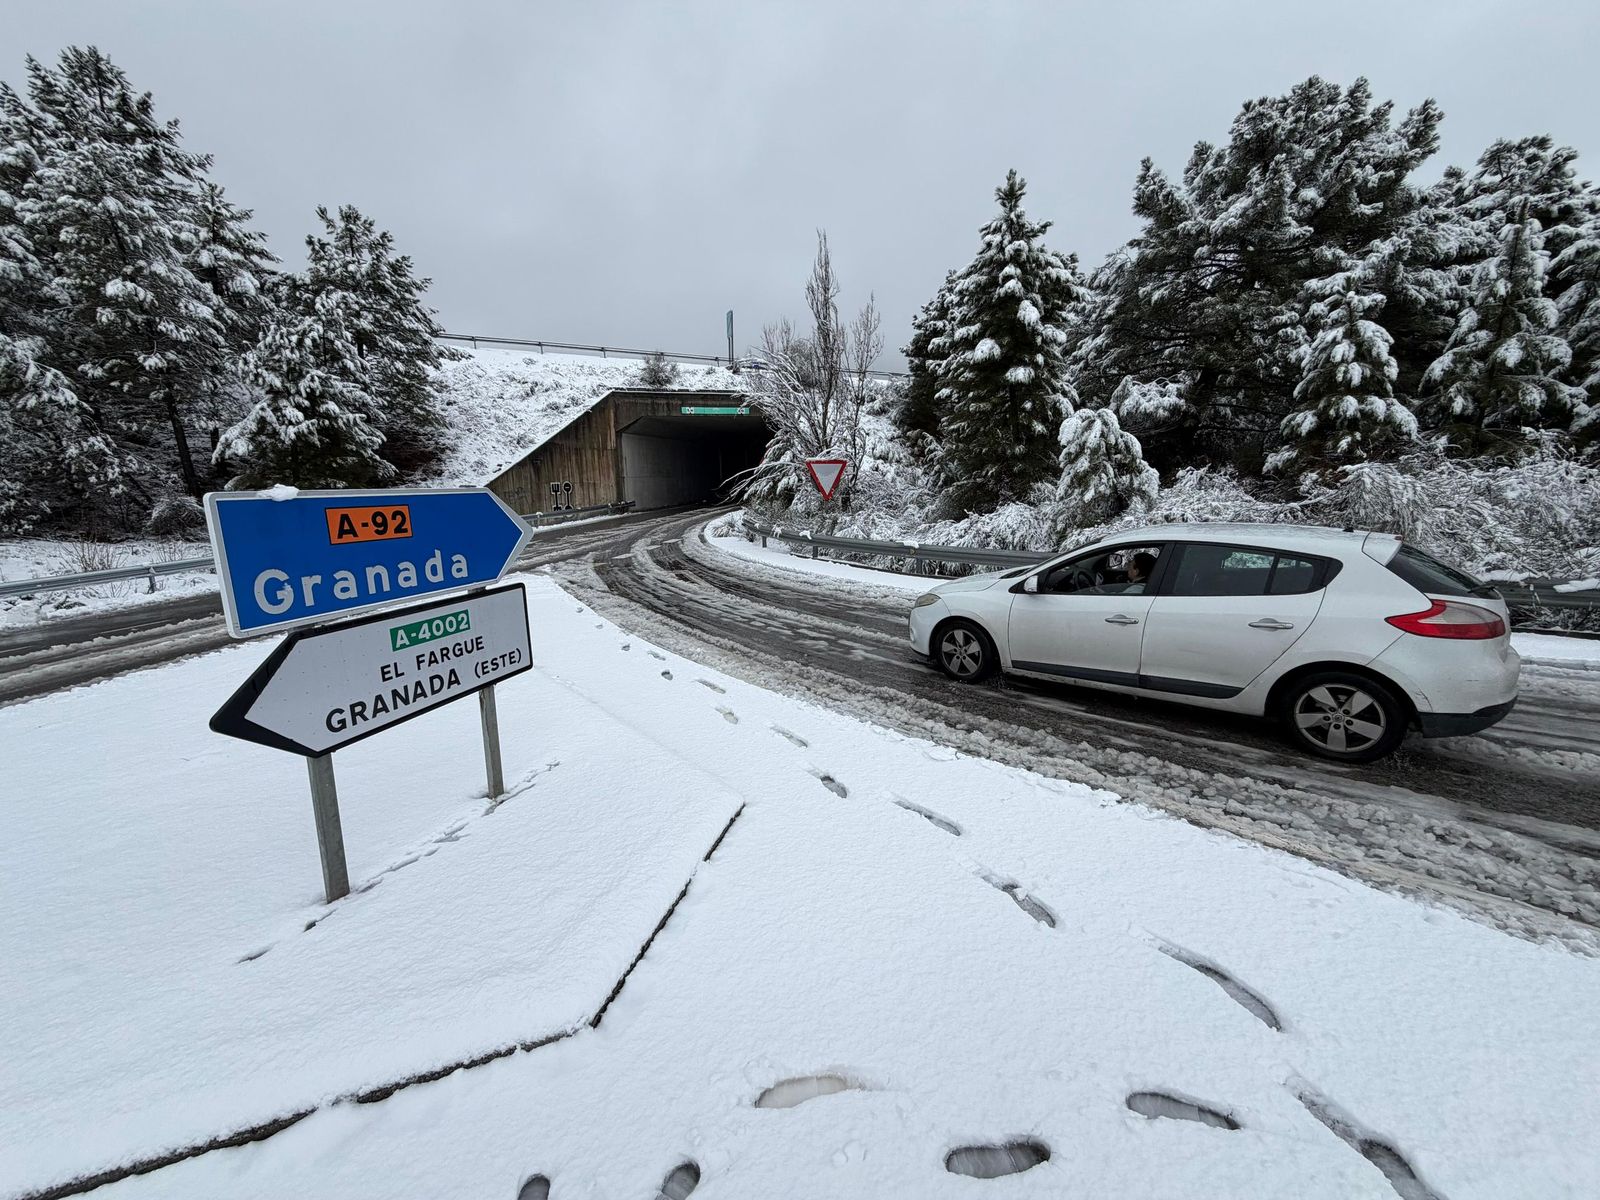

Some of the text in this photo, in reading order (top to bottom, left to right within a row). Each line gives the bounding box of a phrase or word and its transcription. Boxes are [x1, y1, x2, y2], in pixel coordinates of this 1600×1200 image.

[337, 511, 409, 539] A-92
[254, 549, 469, 615] Granada
[395, 614, 470, 650] A-4002
[380, 636, 485, 682] EL FARGUE
[325, 648, 522, 733] GRANADA (ESTE)
